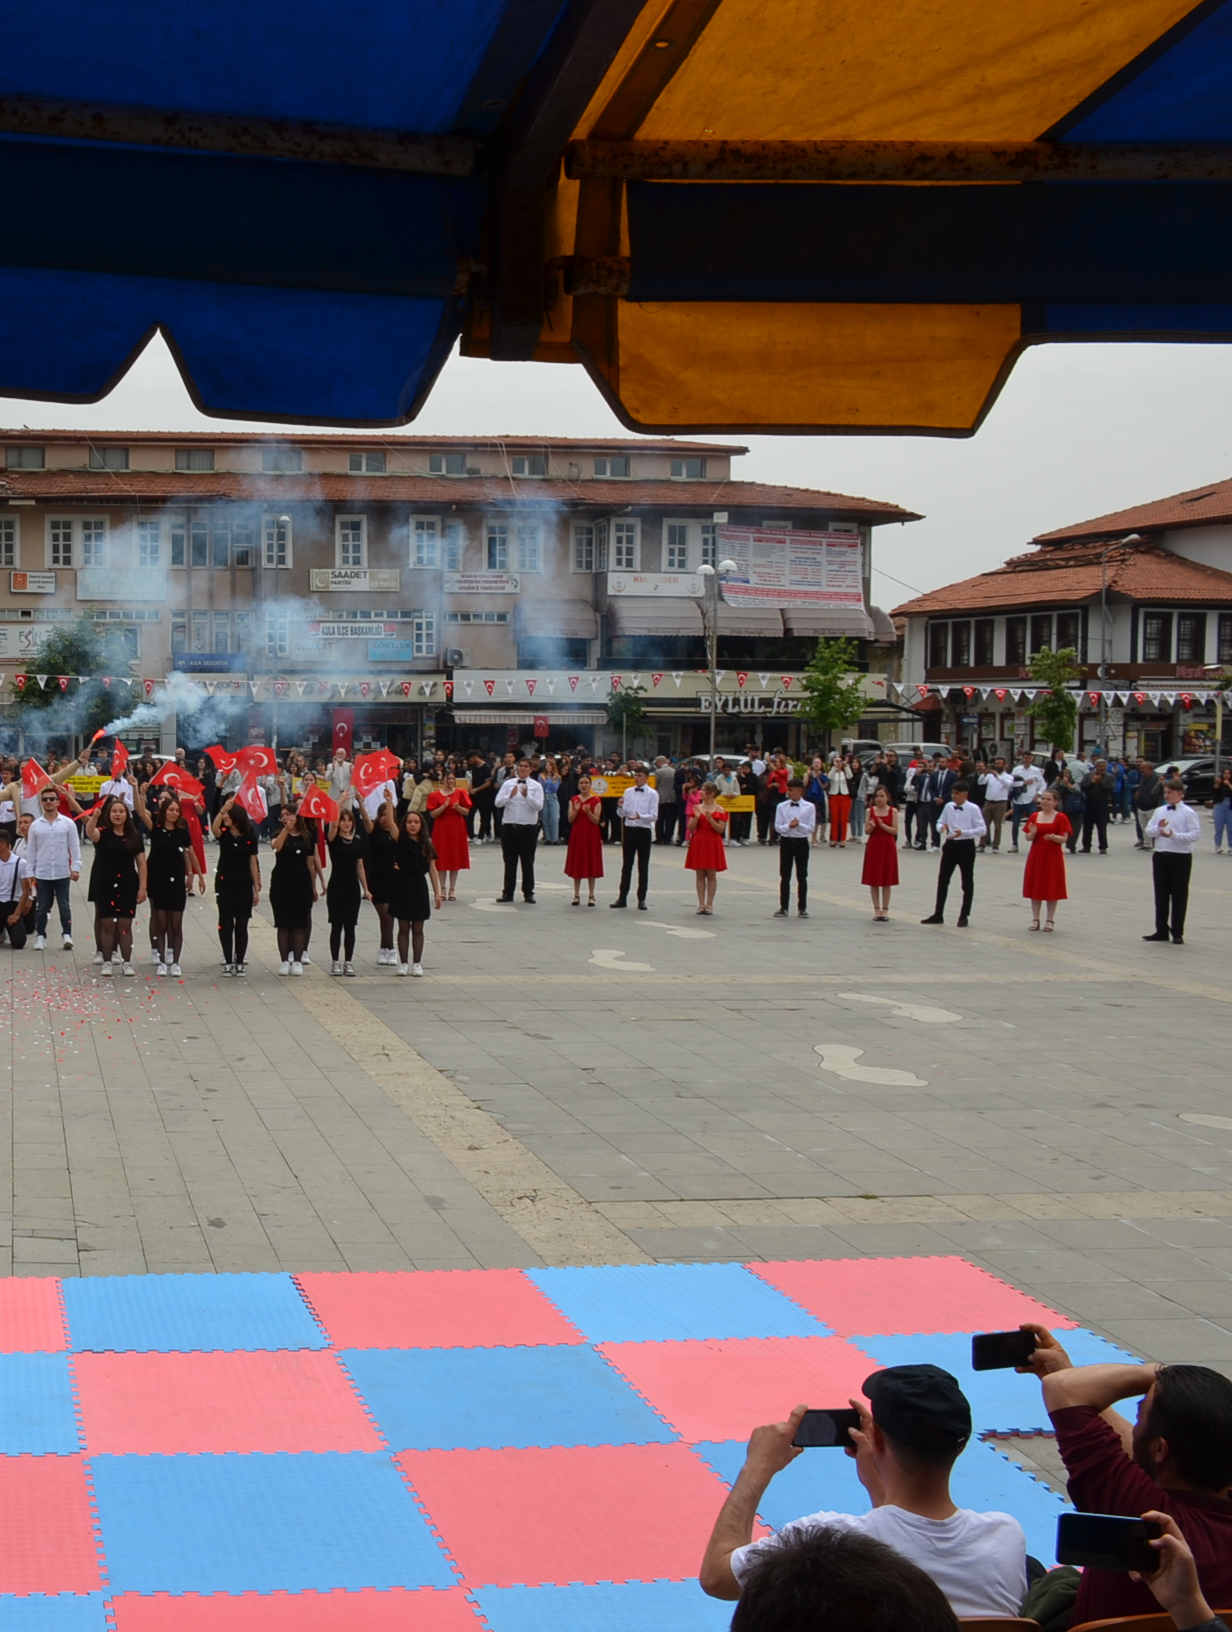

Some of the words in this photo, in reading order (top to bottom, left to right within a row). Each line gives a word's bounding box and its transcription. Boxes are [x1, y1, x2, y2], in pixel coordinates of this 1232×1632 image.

[330, 571, 368, 579] SAADET
[321, 625, 336, 636] KULA
[336, 624, 349, 637] İLÇE
[350, 624, 383, 637] BAŞKANLIĞI
[294, 641, 334, 651] AVUKAT
[699, 690, 765, 713] EYLÜL
